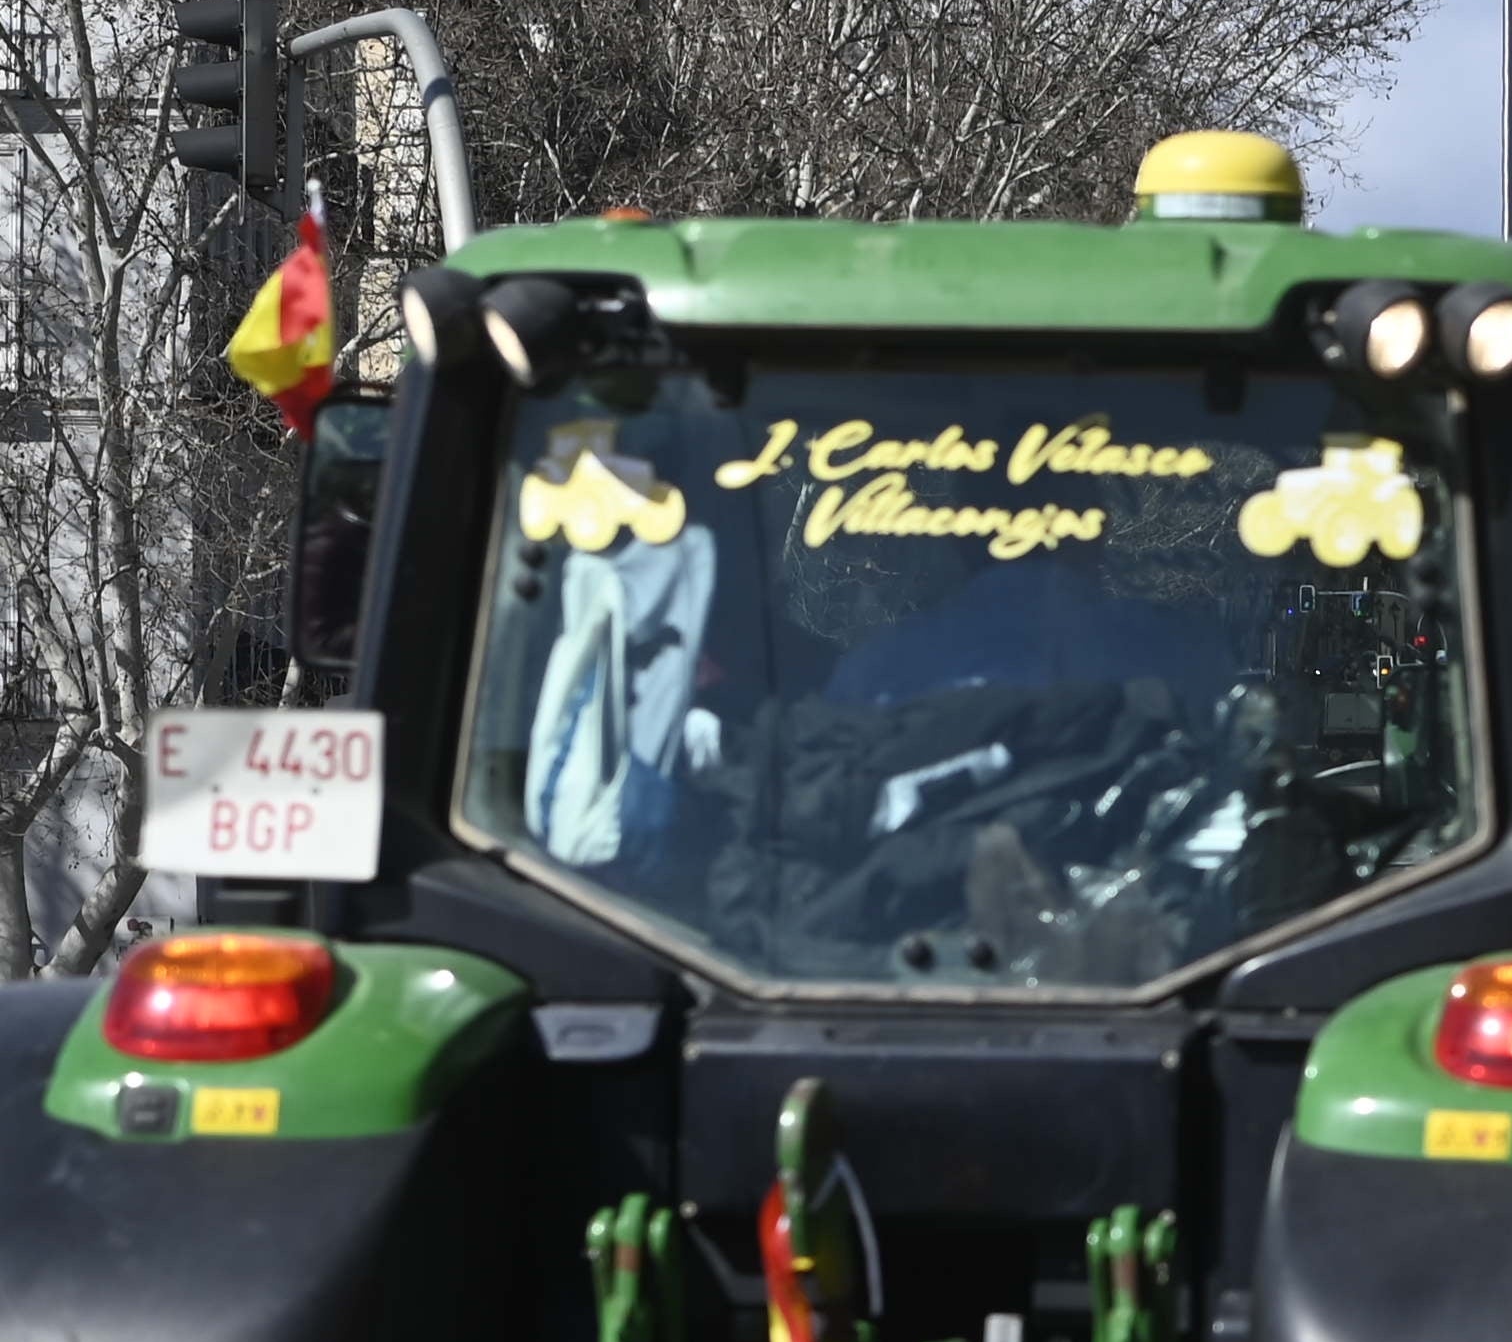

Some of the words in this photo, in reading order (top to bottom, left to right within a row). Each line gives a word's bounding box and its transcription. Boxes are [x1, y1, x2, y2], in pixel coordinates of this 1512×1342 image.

[806, 419, 998, 481] Carlos
[1007, 413, 1213, 486] Velasco
[159, 724, 189, 778] E
[244, 728, 373, 781] 4430
[208, 799, 316, 852] BGP
